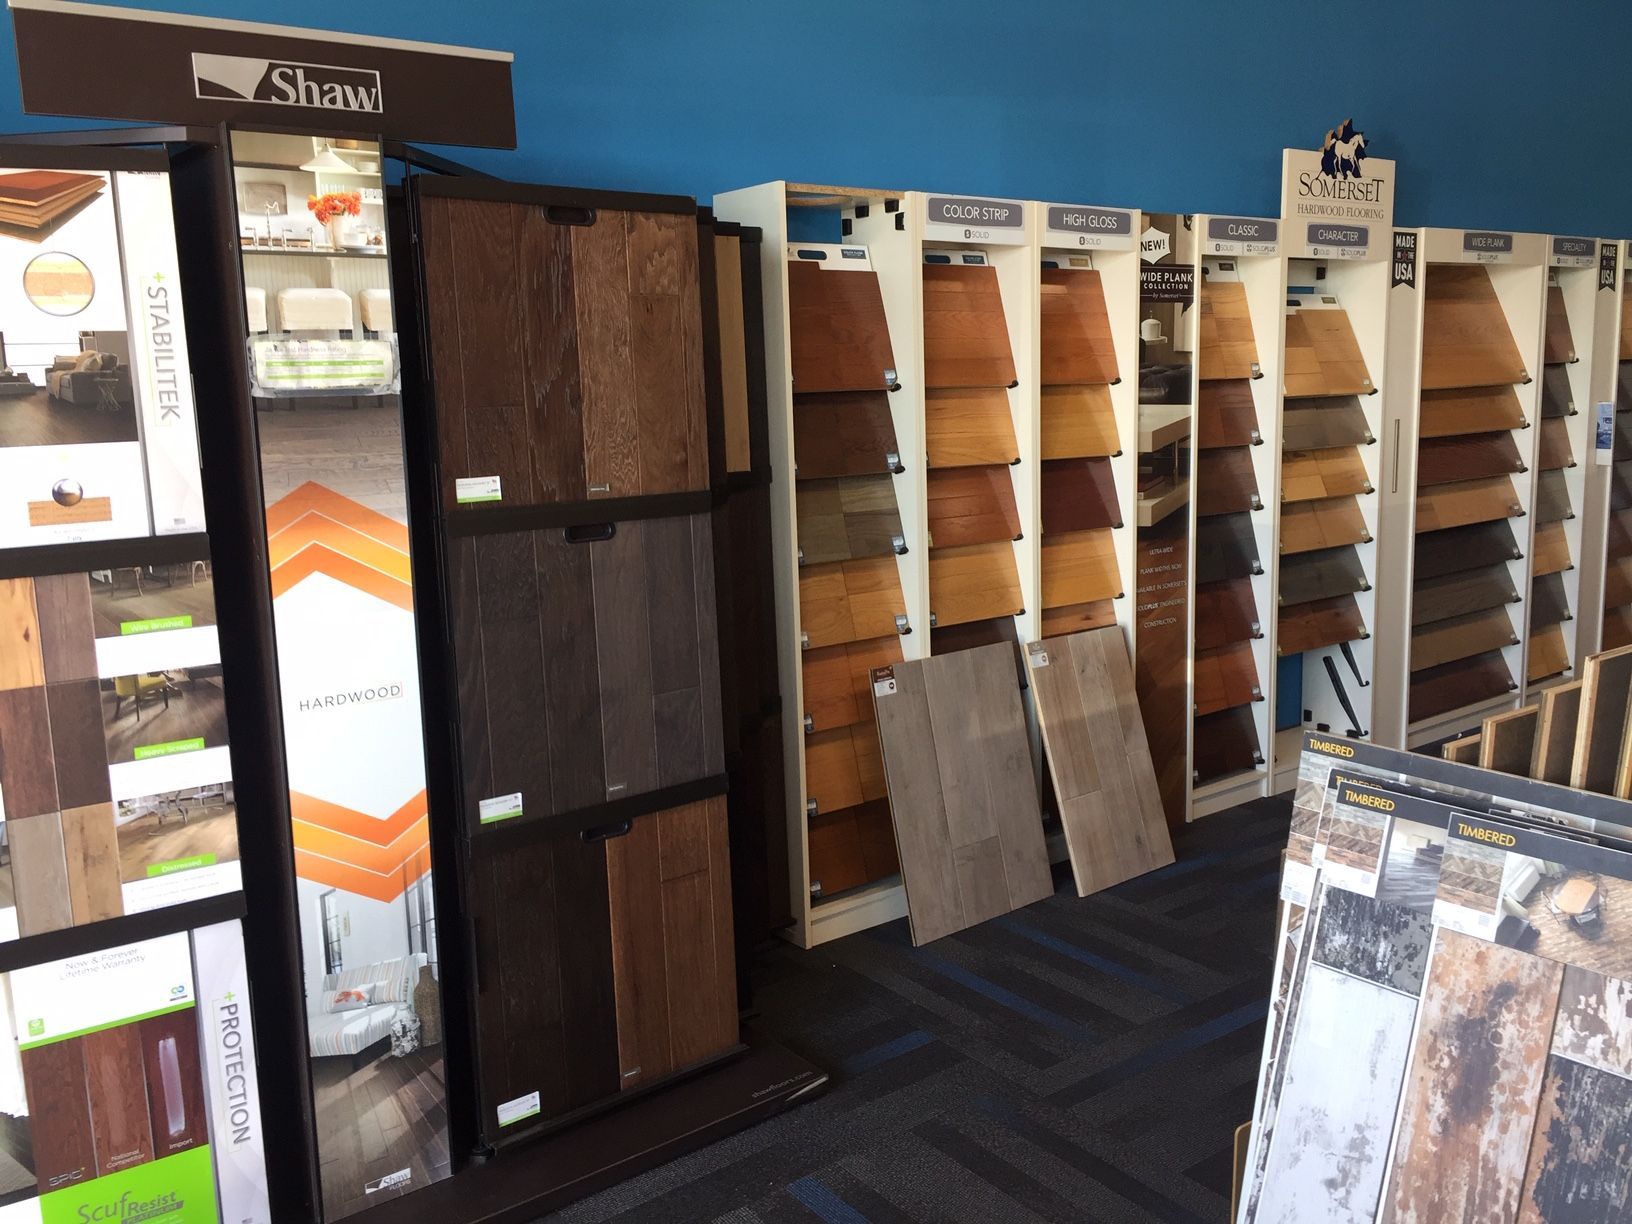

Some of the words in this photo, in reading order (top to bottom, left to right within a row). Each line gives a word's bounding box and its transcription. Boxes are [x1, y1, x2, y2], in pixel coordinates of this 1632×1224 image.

[271, 67, 378, 112] Shaw
[1298, 172, 1385, 202] SOMERSET
[943, 204, 980, 219] COLOR
[983, 208, 1010, 222] STRIP
[1297, 203, 1345, 217] HARDWOOD
[1346, 206, 1384, 220] FLOORING
[1063, 213, 1086, 227] HIGH
[1088, 215, 1118, 229] GLOSS
[971, 230, 990, 239] SOLID
[1227, 223, 1260, 237] CLASSIC
[1317, 229, 1359, 242] CHARACTER
[1085, 238, 1102, 246] SOLID
[1140, 239, 1166, 252] NEW!
[1395, 235, 1415, 248] MADE
[1472, 237, 1486, 247] WIDE
[1487, 238, 1505, 248] PLANK
[1562, 242, 1587, 252] SPECIALTY
[1602, 246, 1616, 257] MADE
[1140, 272, 1162, 282] WIDE
[1164, 272, 1193, 283] PLANK
[1394, 262, 1413, 280] USA
[1601, 269, 1615, 285] USA
[298, 683, 402, 712] HARDWOOD
[1309, 738, 1355, 758] TIMBERED
[1345, 789, 1395, 811] TIMBERED
[1458, 823, 1516, 847] TIMBERED
[65, 959, 91, 970] Now
[91, 956, 99, 965] &
[101, 948, 139, 962] Forever
[59, 965, 100, 981] Lifetime
[103, 954, 146, 971] Warranty
[169, 1137, 193, 1150] Import
[106, 1153, 146, 1169] Competitor
[111, 1148, 140, 1162] National
